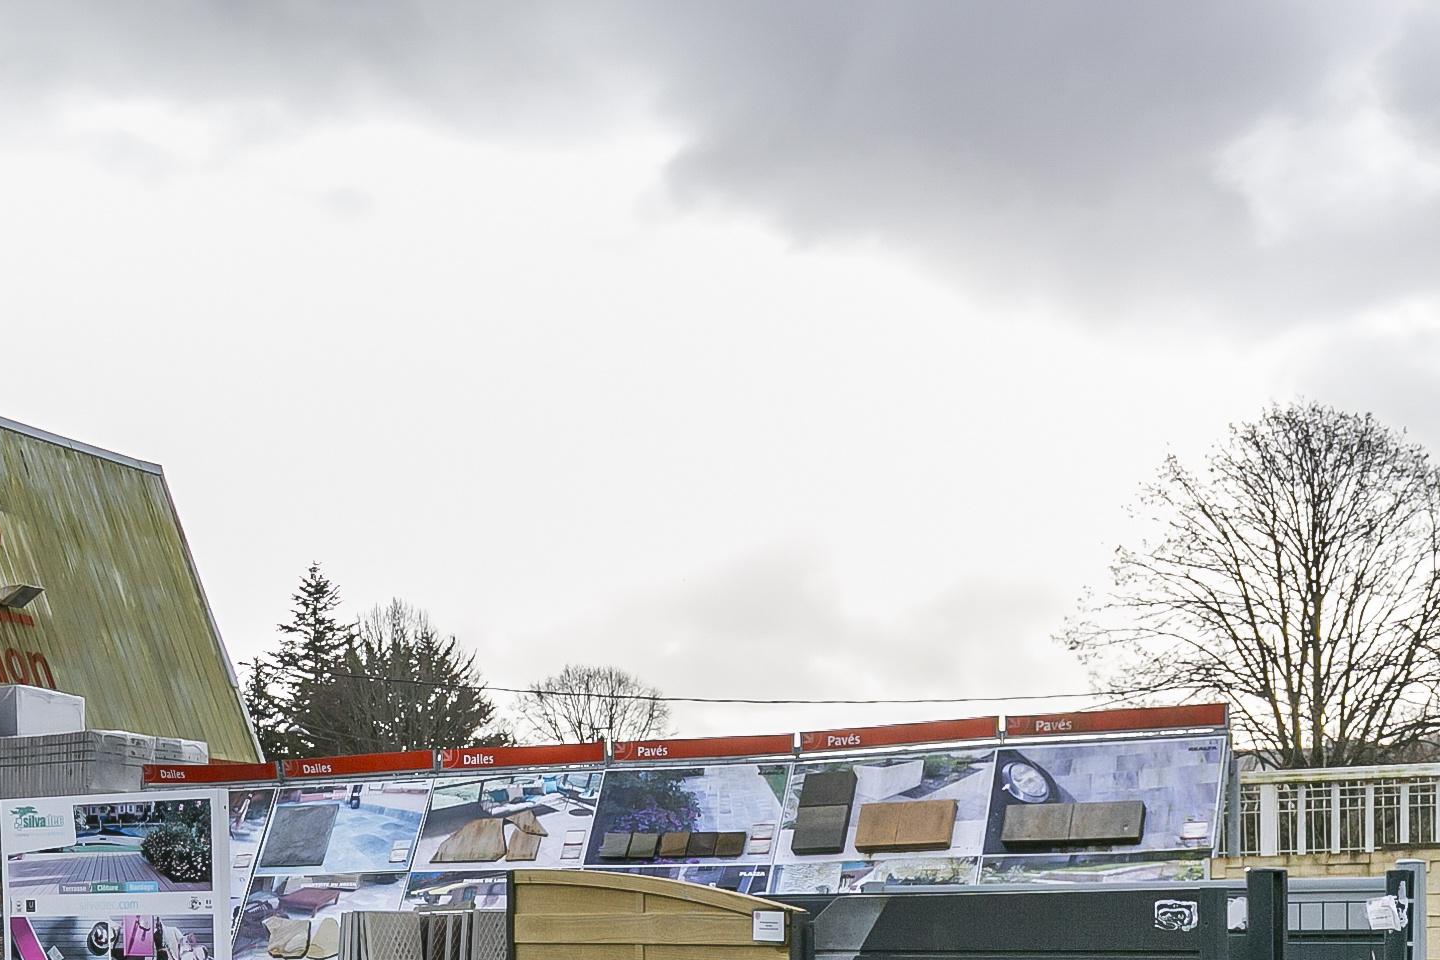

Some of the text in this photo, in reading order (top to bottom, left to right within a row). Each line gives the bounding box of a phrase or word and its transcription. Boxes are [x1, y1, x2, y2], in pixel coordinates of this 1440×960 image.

[1035, 718, 1073, 733] Pavés
[826, 732, 861, 748] Pavés
[463, 752, 495, 766] Dalles
[636, 744, 668, 759] Pavés
[160, 769, 186, 780] Dalles
[302, 761, 333, 776] Dalles
